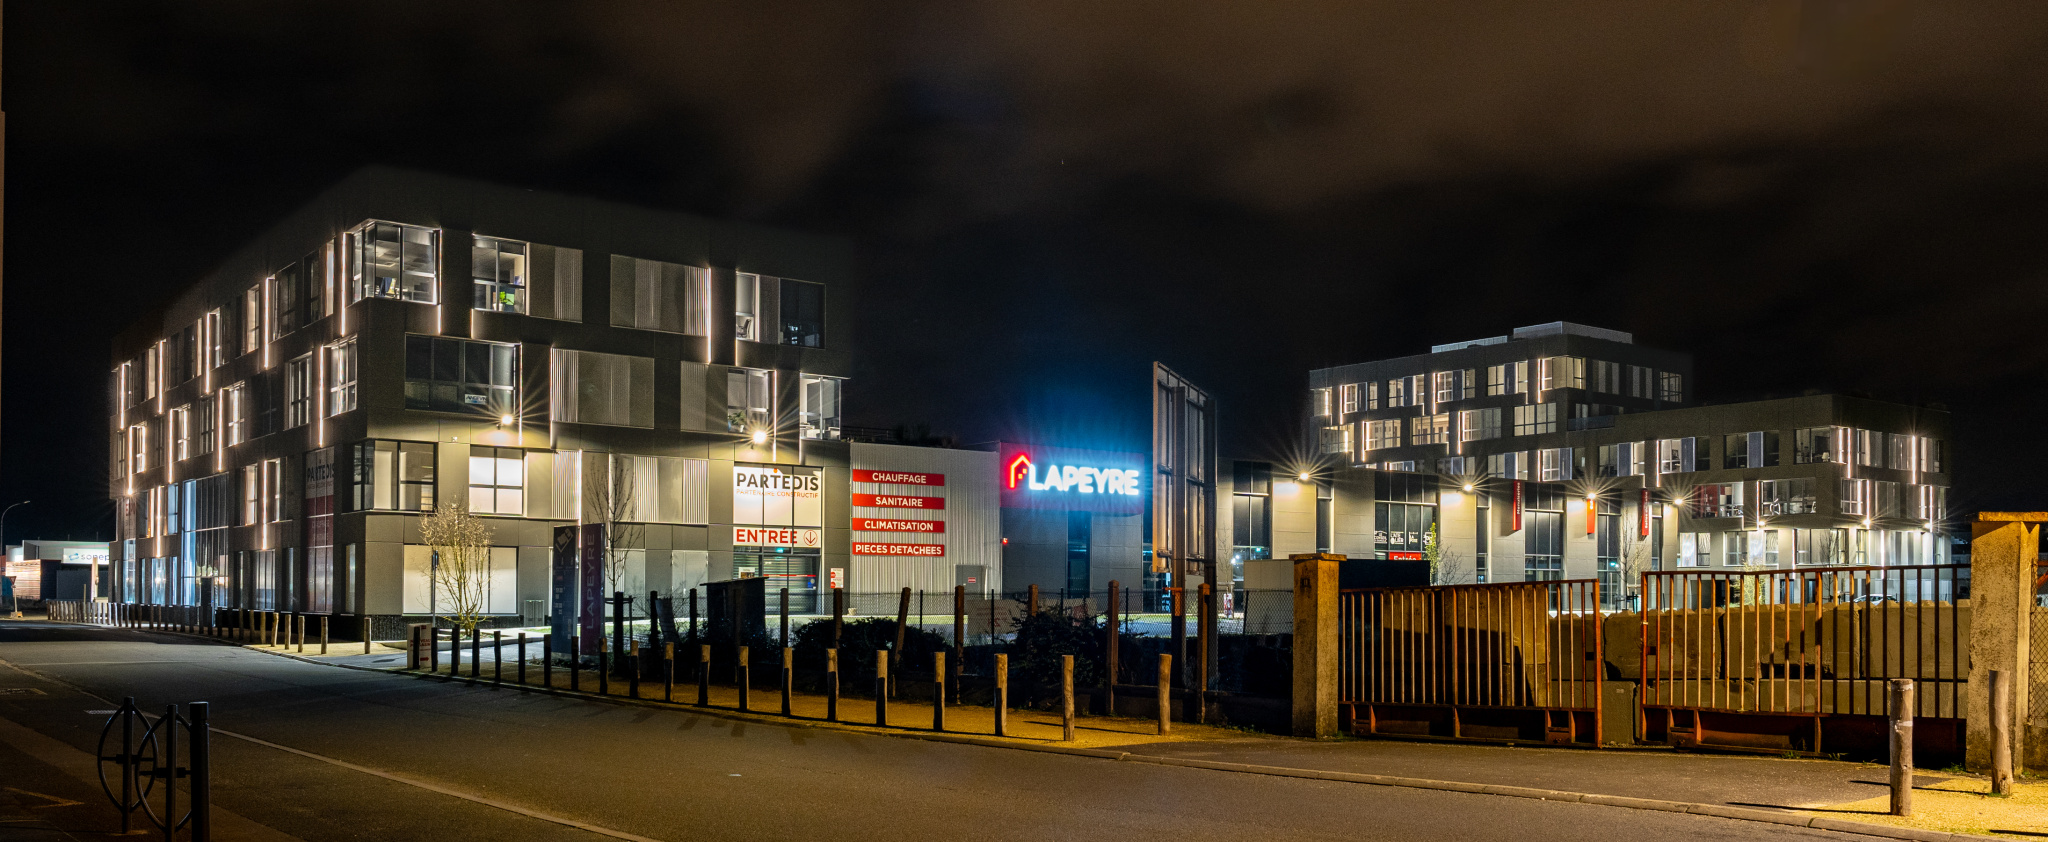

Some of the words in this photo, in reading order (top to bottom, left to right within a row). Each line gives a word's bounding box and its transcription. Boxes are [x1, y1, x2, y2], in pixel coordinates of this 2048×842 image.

[736, 473, 819, 491] PARTEDIS
[872, 472, 927, 484] CHAUFFAGE
[1029, 465, 1139, 495] LAPEYRE
[736, 489, 775, 497] PARTENAIRE
[777, 491, 819, 499] CONSTRUCTIF
[875, 496, 923, 507] SANITAIRE
[864, 520, 934, 531] CLIMATISATION
[736, 527, 798, 544] ENTRÉE
[855, 544, 888, 553] PIECES
[890, 545, 942, 555] DETACHEES
[586, 534, 595, 629] LAPEYRE
